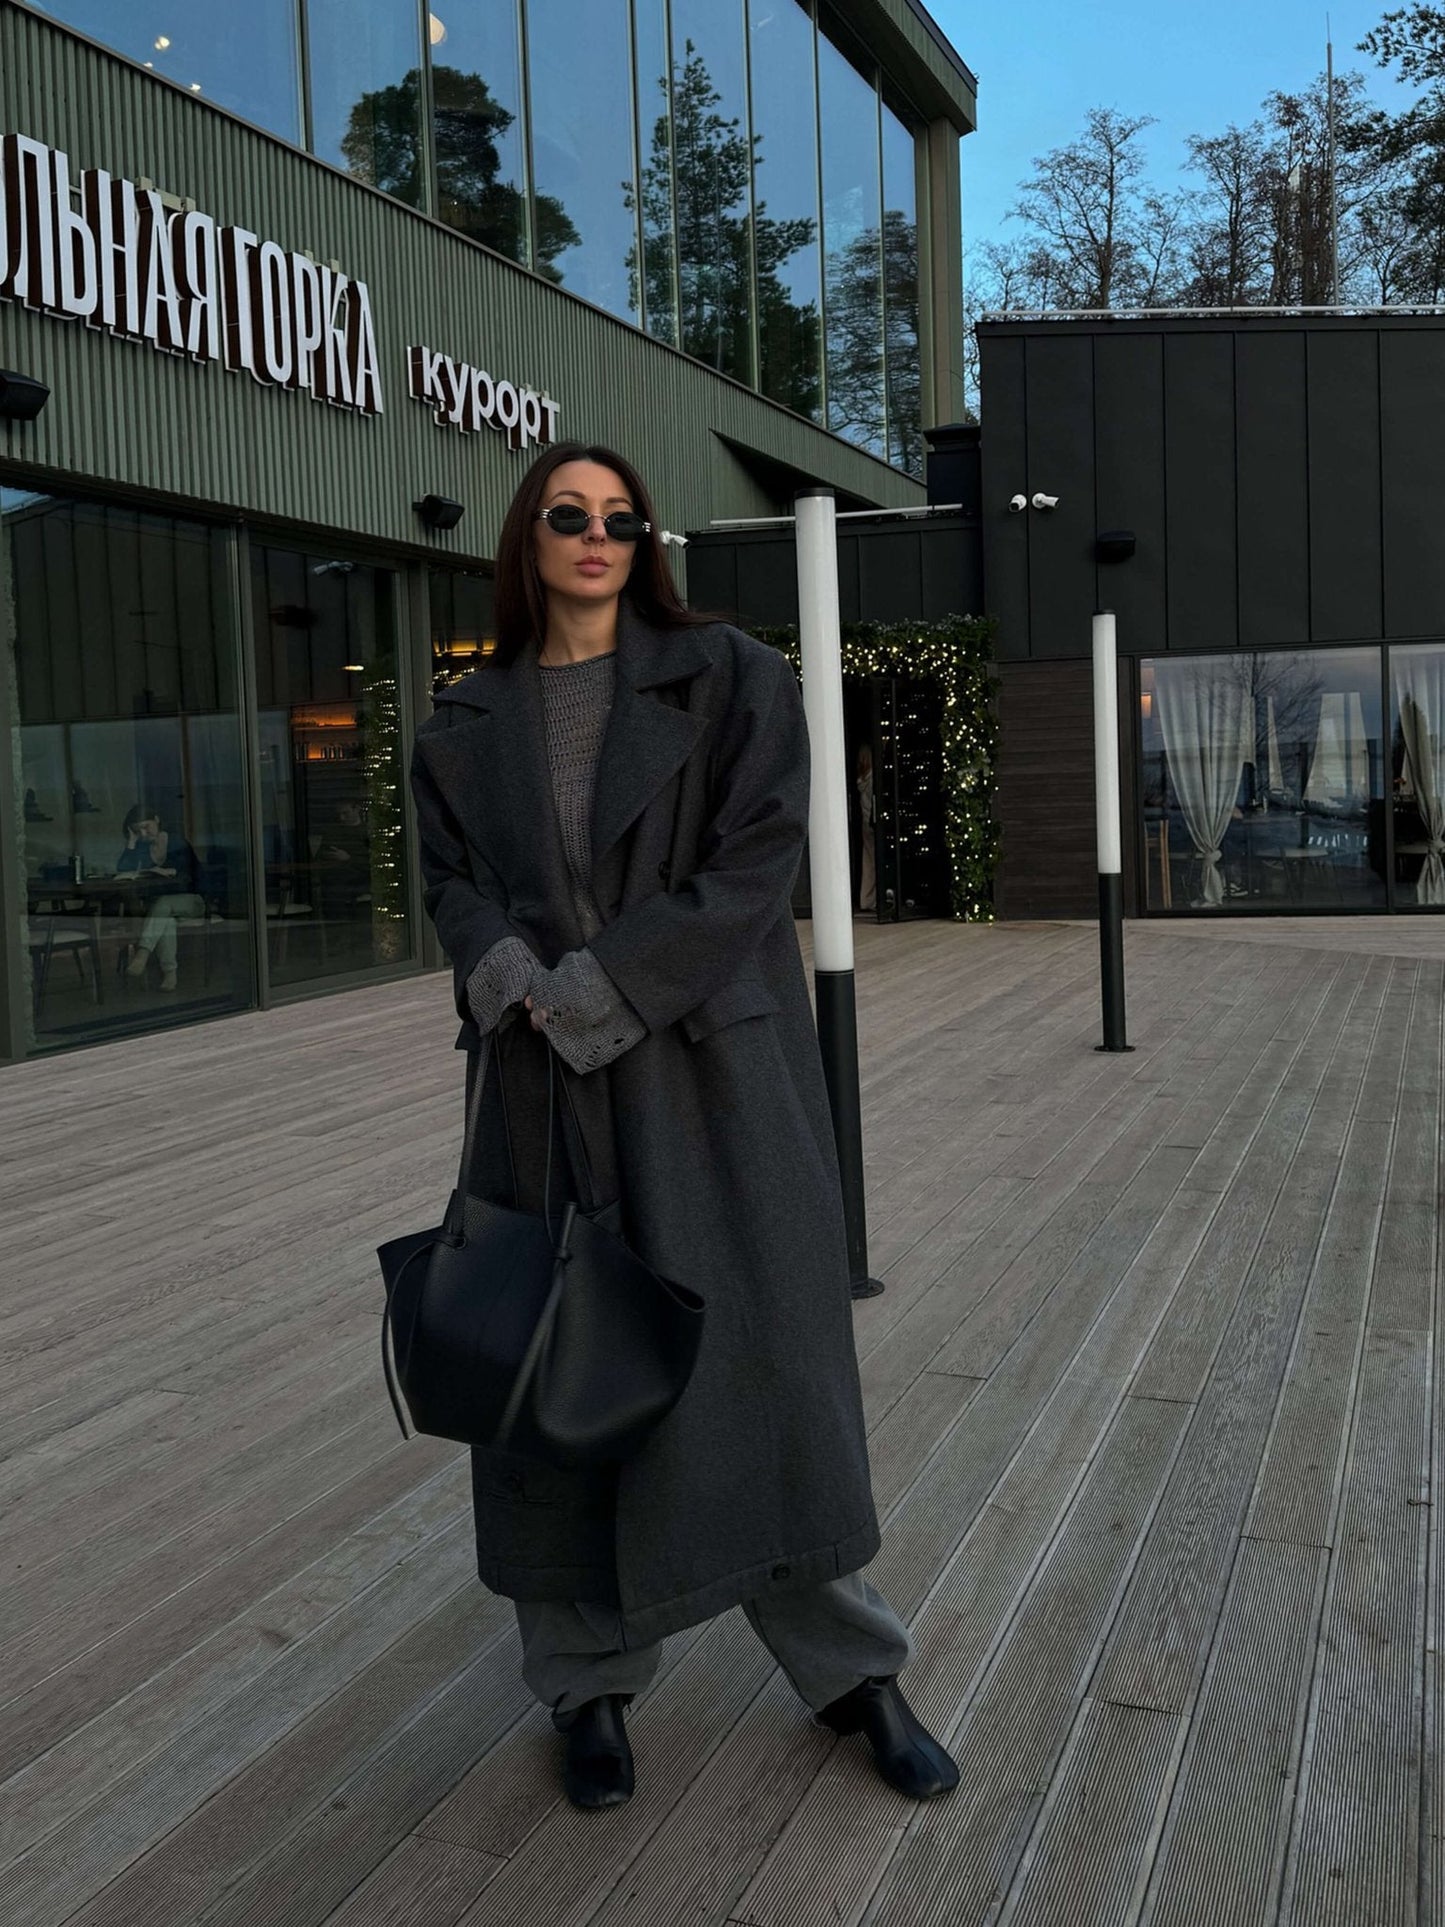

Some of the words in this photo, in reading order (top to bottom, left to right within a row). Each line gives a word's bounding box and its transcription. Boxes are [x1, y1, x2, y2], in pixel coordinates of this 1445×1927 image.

[0, 132, 220, 361] ЛЬНАЯ
[218, 226, 384, 416] ГОРКА
[407, 345, 561, 450] курорт
